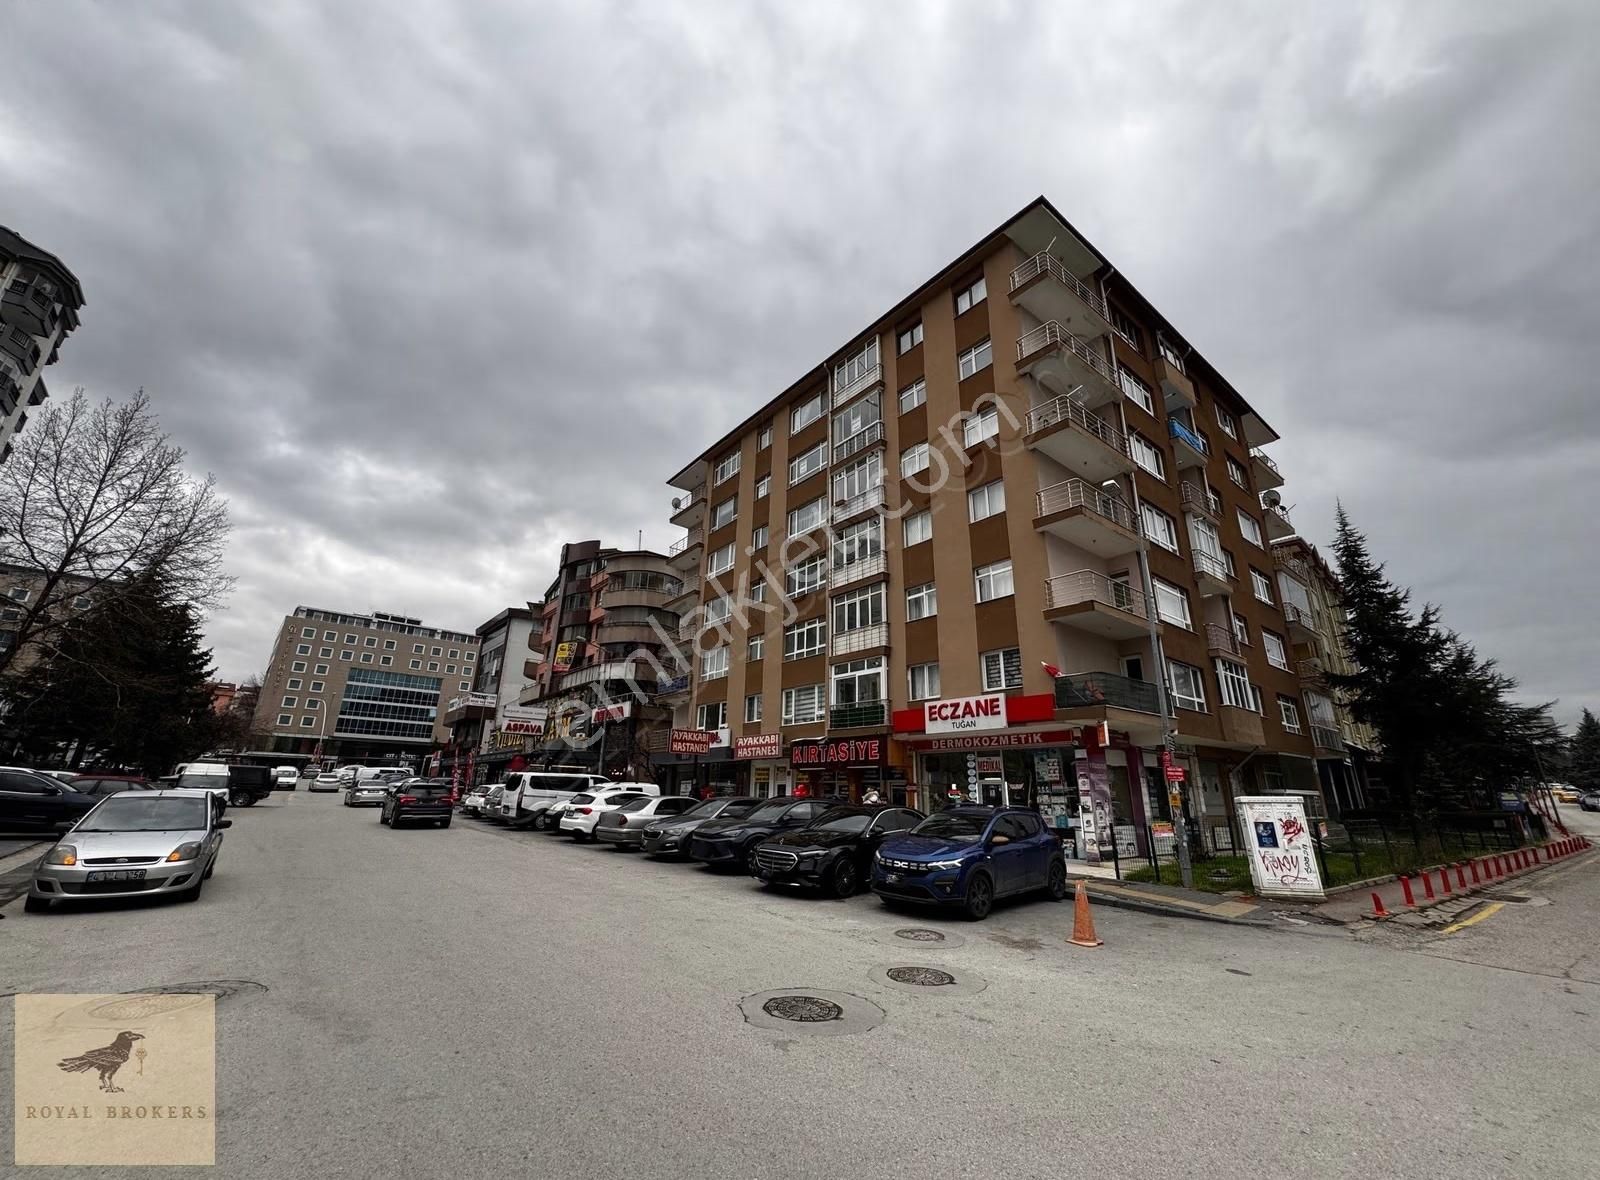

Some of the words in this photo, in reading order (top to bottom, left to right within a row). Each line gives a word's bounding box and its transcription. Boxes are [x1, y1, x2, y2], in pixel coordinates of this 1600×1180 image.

[928, 698, 1001, 721] ECZANE
[952, 720, 977, 729] TUĞAN
[672, 730, 709, 741] AYAKKABI
[737, 734, 779, 746] AYAKKABI
[932, 733, 1043, 749] DERMOKOZMETİK
[792, 740, 880, 763] KIRTASİYE
